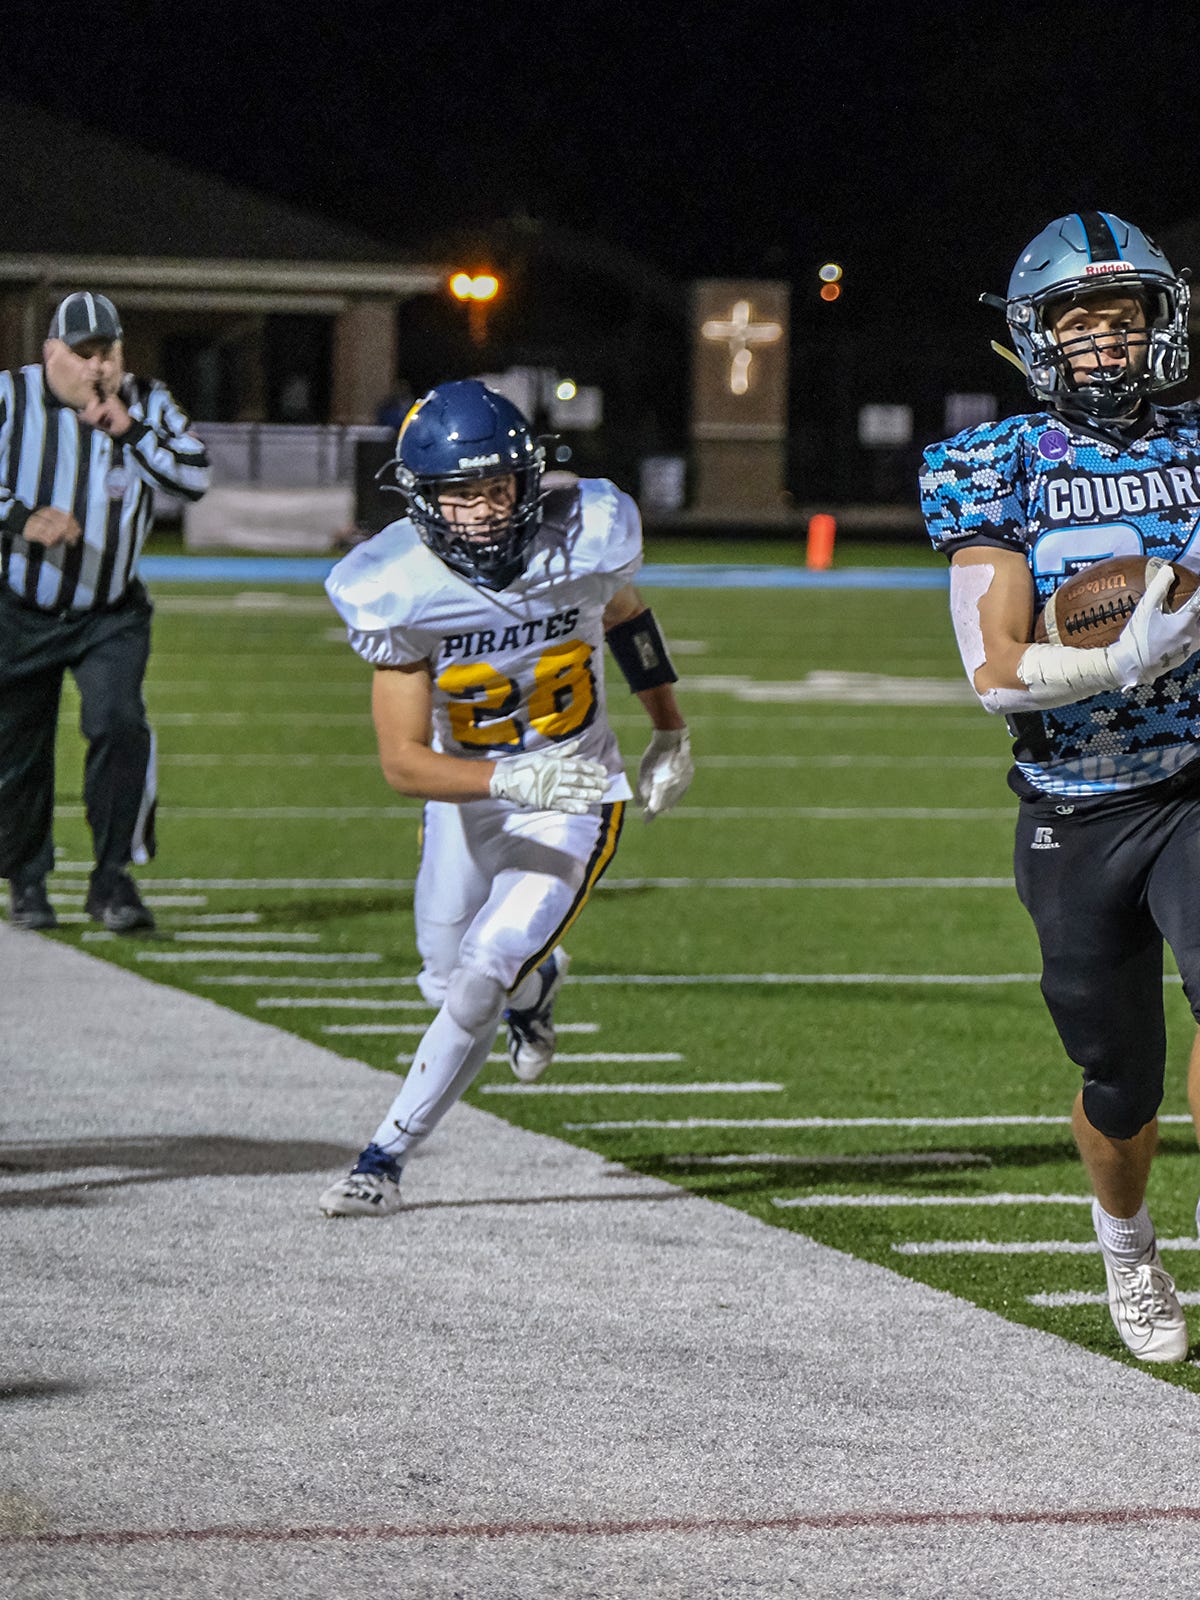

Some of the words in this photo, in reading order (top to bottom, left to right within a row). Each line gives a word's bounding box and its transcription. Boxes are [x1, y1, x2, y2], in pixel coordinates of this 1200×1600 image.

[1067, 573, 1127, 601] Wilson
[442, 607, 580, 658] PIRATES
[437, 639, 598, 751] 28
